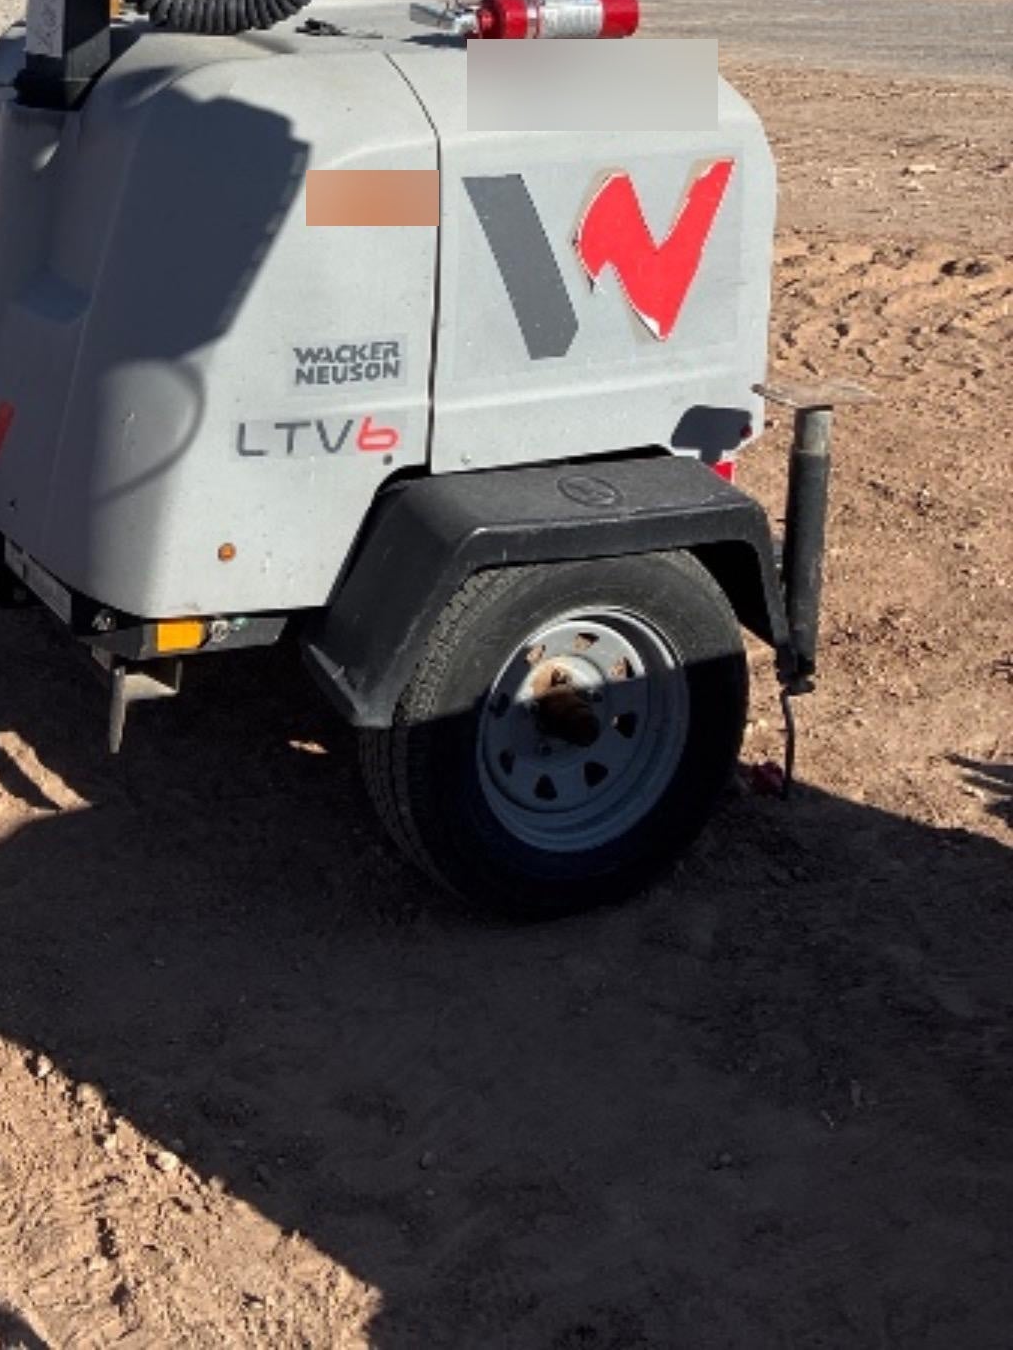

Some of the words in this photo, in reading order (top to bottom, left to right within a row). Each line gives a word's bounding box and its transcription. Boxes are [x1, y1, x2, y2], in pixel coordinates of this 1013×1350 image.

[293, 341, 400, 365] WACKER
[294, 360, 400, 386] NEUSON
[237, 416, 399, 457] LTV6
